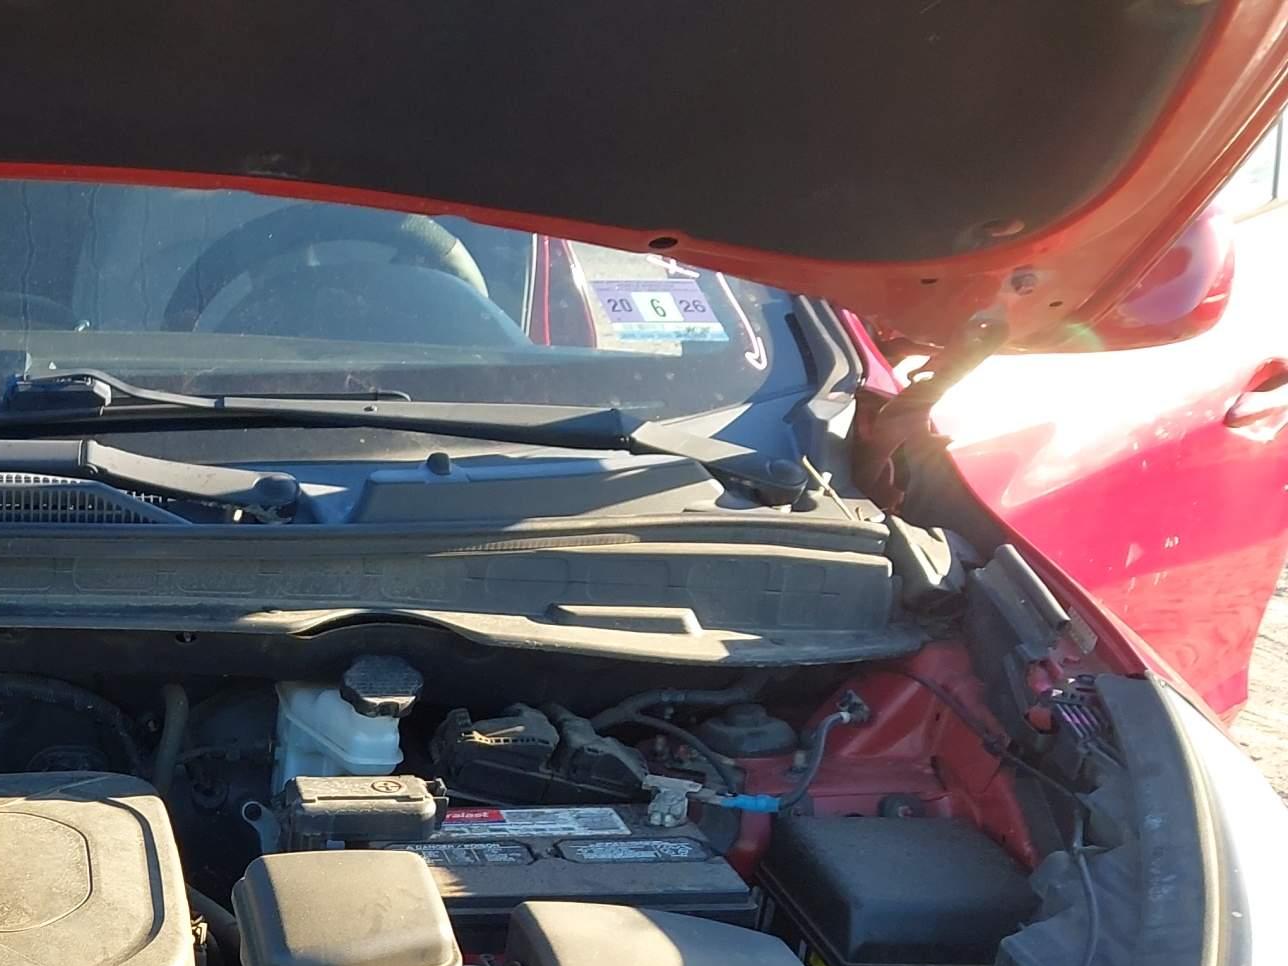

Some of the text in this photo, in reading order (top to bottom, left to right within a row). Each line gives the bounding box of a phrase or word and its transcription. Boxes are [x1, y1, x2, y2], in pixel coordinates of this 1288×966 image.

[607, 298, 706, 318] 20 6 26
[445, 811, 489, 819] ralast
